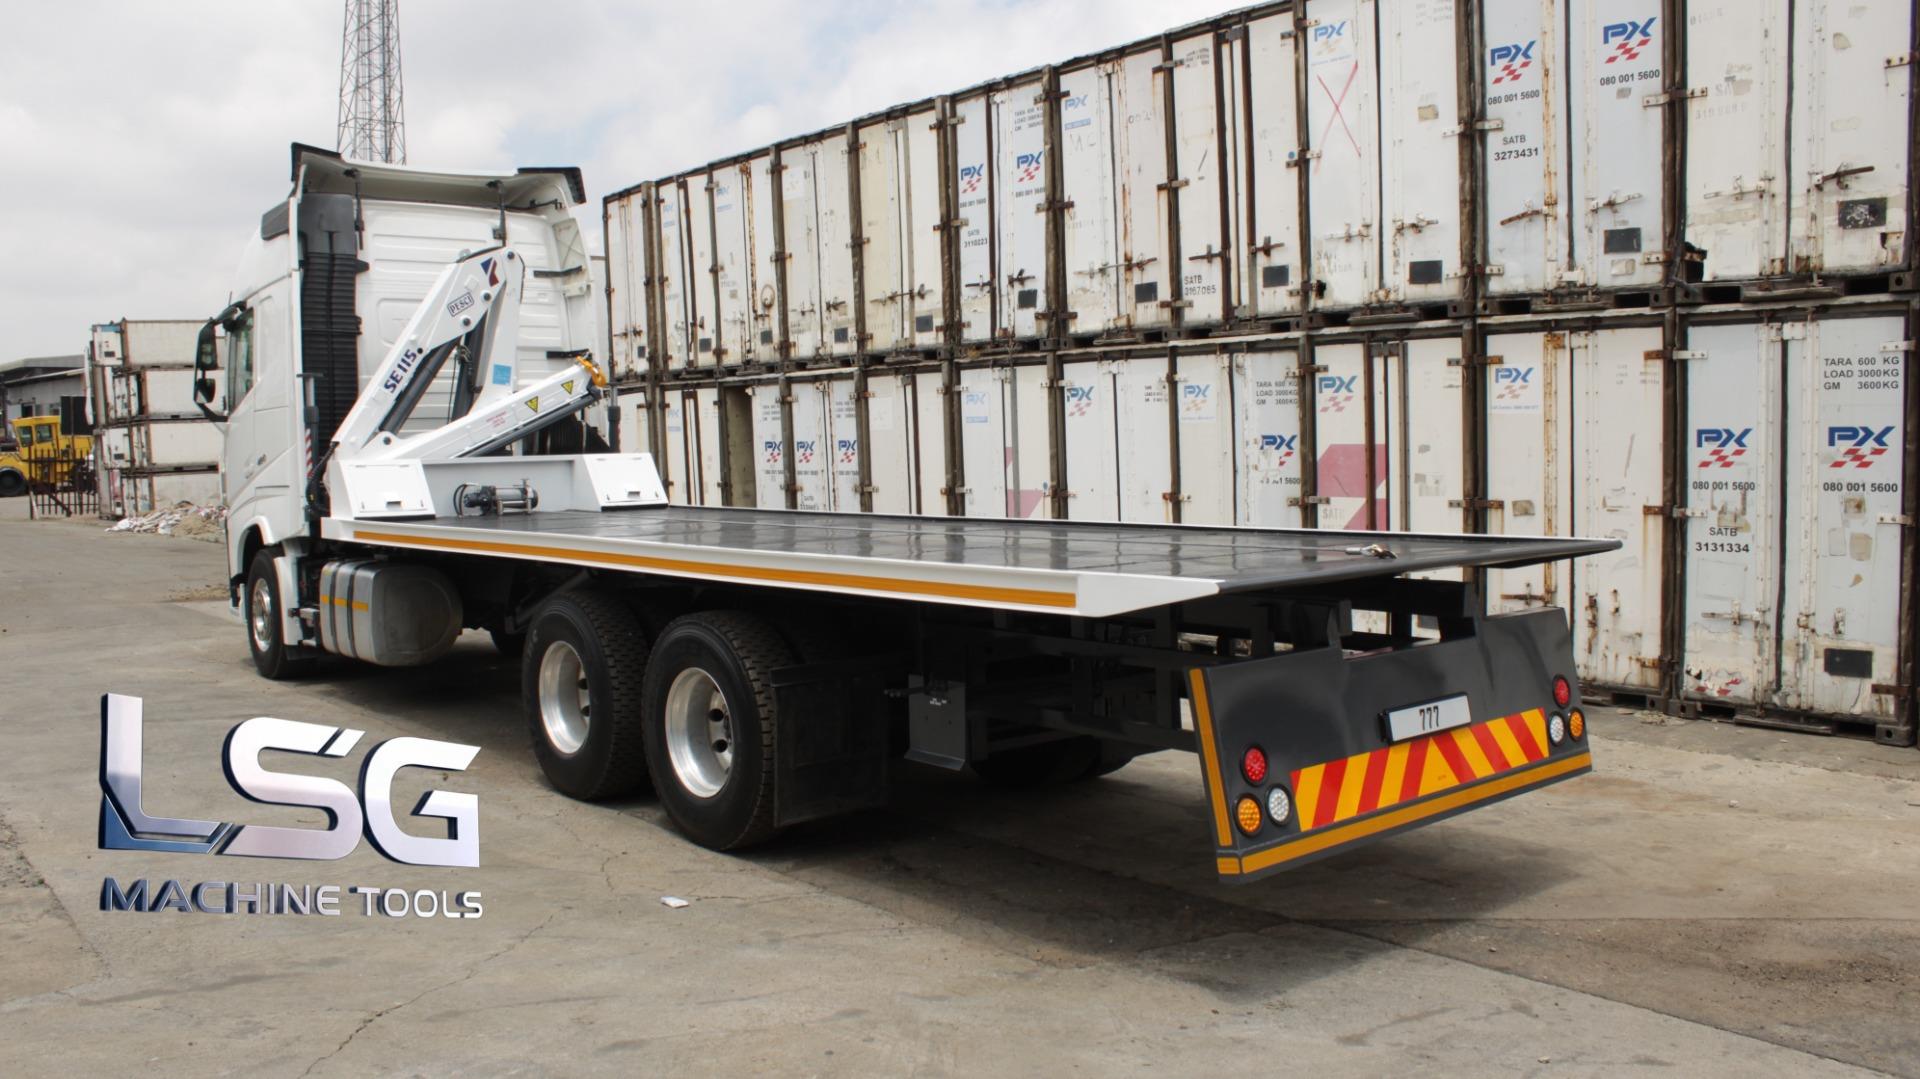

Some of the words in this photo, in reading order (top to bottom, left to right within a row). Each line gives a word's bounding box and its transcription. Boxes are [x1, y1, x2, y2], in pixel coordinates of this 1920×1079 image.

[1314, 21, 1346, 42] PX
[1602, 17, 1657, 44] PX
[1490, 40, 1536, 66] PX
[1600, 75, 1616, 86] 080
[1618, 73, 1635, 84] 001
[1638, 69, 1660, 82] 5600
[1504, 93, 1518, 103] 001
[1521, 89, 1540, 101] 5600
[1502, 134, 1527, 146] SATB
[1016, 151, 1043, 169] PX
[1494, 147, 1539, 161] 3273431
[961, 163, 984, 181] PX
[1183, 274, 1202, 286] SATB
[449, 295, 473, 314] PESCI
[1823, 358, 1853, 366] TARA
[1858, 357, 1876, 366] 600
[1883, 356, 1900, 365] KG
[1495, 367, 1534, 384] PX
[1823, 369, 1854, 379] LOAD
[1184, 384, 1210, 399] PX
[1318, 376, 1357, 394] PX
[1823, 381, 1841, 390] GM
[1066, 386, 1094, 402] PX
[1259, 434, 1297, 451] PX
[1696, 428, 1753, 448] PX
[1828, 426, 1896, 447] PX
[765, 441, 782, 452] PX
[796, 441, 815, 452] PX
[838, 440, 857, 452] PX
[1692, 481, 1709, 491] 080
[1712, 481, 1729, 491] 001
[1732, 481, 1755, 491] 5600
[1823, 482, 1843, 492] 080
[1846, 482, 1866, 492] 001
[1870, 482, 1898, 493] 5600
[1709, 527, 1737, 537] SATB
[1695, 542, 1750, 553] 3131334
[1419, 706, 1439, 731] 777
